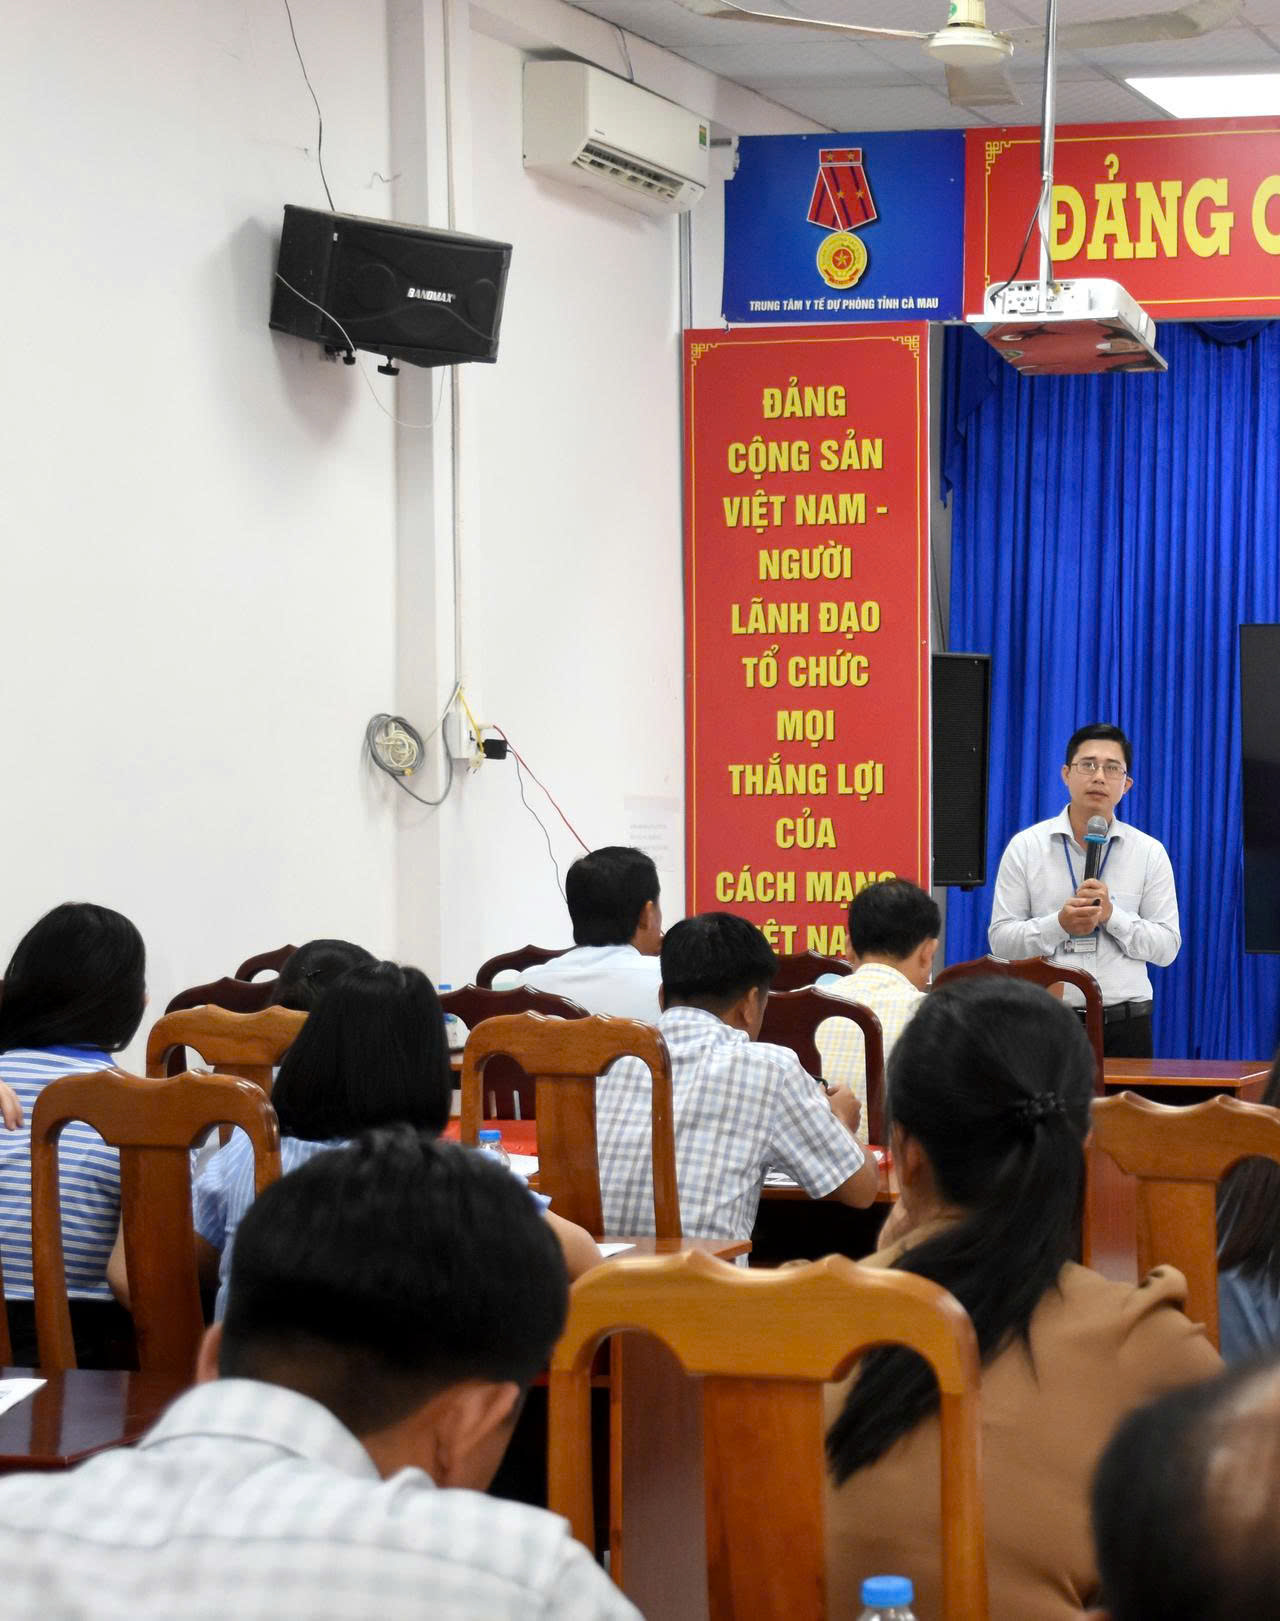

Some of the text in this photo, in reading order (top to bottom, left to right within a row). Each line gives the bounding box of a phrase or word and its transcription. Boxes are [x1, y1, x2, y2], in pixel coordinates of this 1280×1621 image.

[1048, 153, 1235, 262] ĐẢNG
[749, 295, 939, 312] TRUNG TÂM Y TẾ DỰ PHÒNG TỈNH CÀ MAU
[762, 376, 846, 419] ĐẢNG
[727, 428, 883, 480] CỘNG SẢN
[722, 489, 888, 534] VIỆT NAM -
[758, 540, 852, 580] NGƯỜI
[731, 597, 880, 640] LÃNH ĐẠO
[741, 644, 869, 688] TỔ CHỨC
[776, 708, 835, 748] MỌI
[727, 751, 884, 801] THẮNG LỢI
[775, 807, 837, 849] CỦA
[715, 864, 897, 909] CÁCH MẠ
[806, 924, 848, 956] NA
